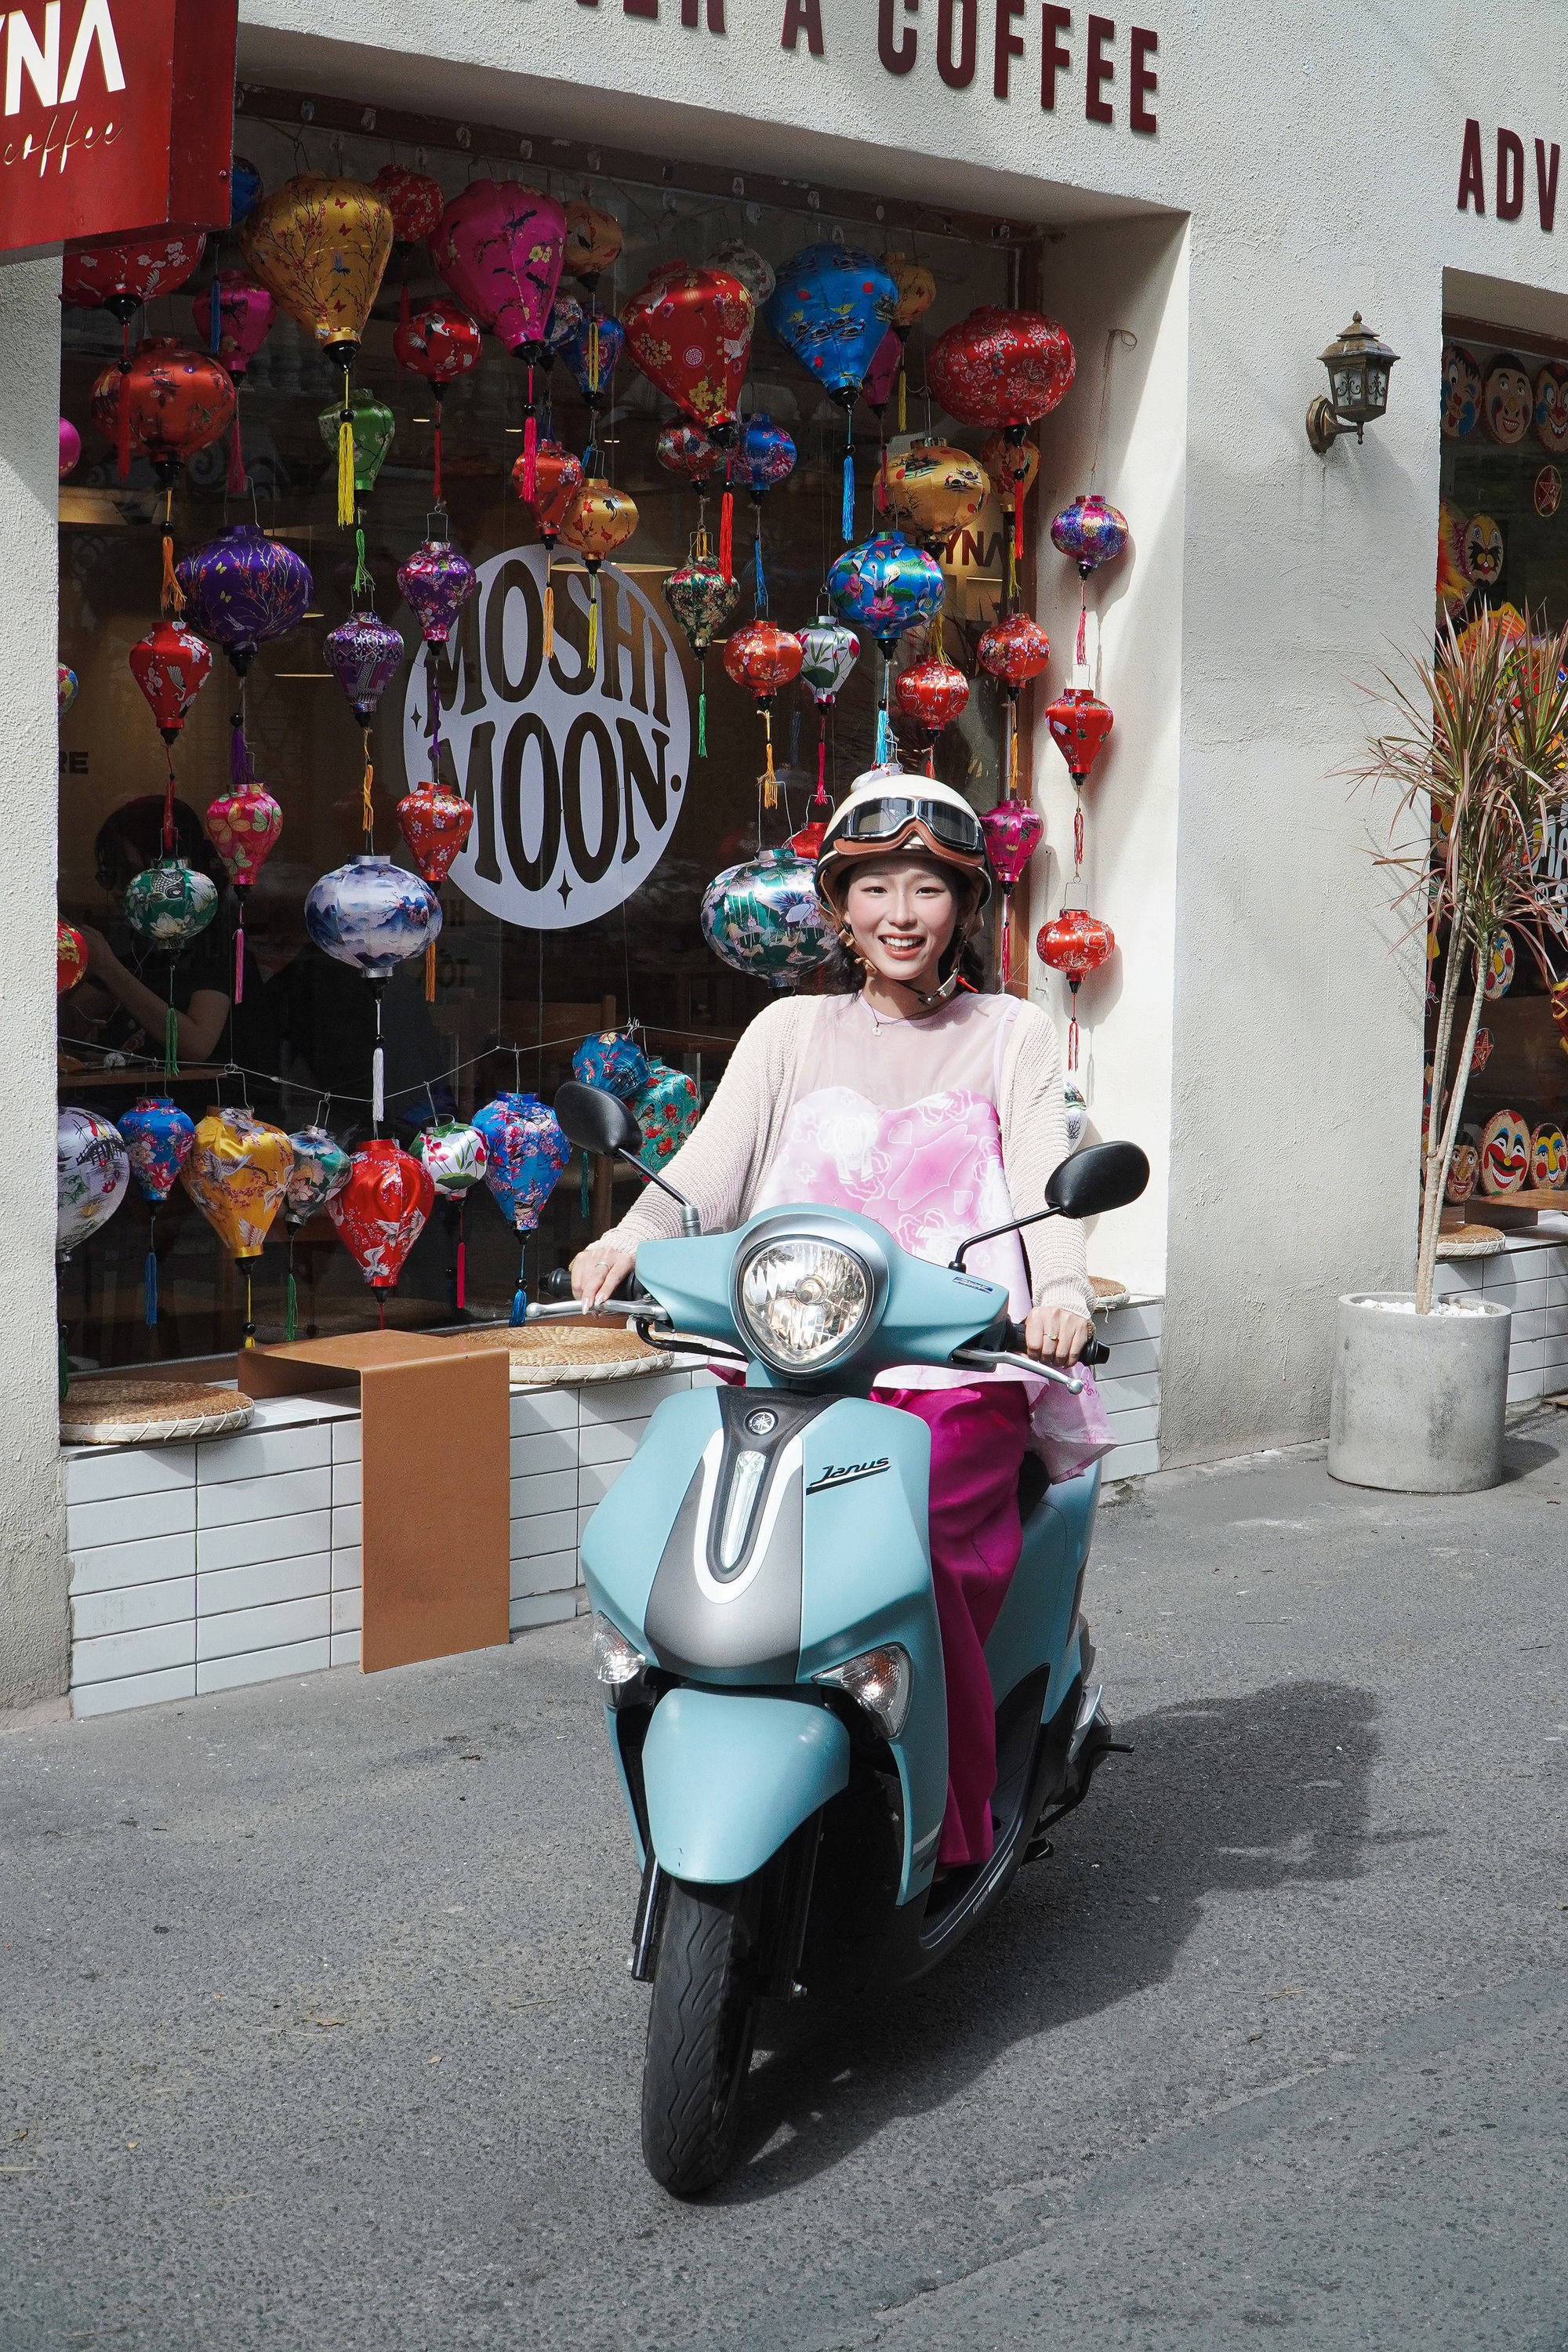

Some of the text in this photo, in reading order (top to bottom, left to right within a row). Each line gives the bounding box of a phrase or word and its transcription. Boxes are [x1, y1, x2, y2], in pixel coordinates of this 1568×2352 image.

[0, 0, 126, 116] NA
[877, 0, 1158, 133] COFFEE
[3, 110, 124, 178] coffee
[1457, 118, 1560, 230] ADV
[423, 556, 671, 738] MOSHI
[809, 1457, 889, 1486] Janus
